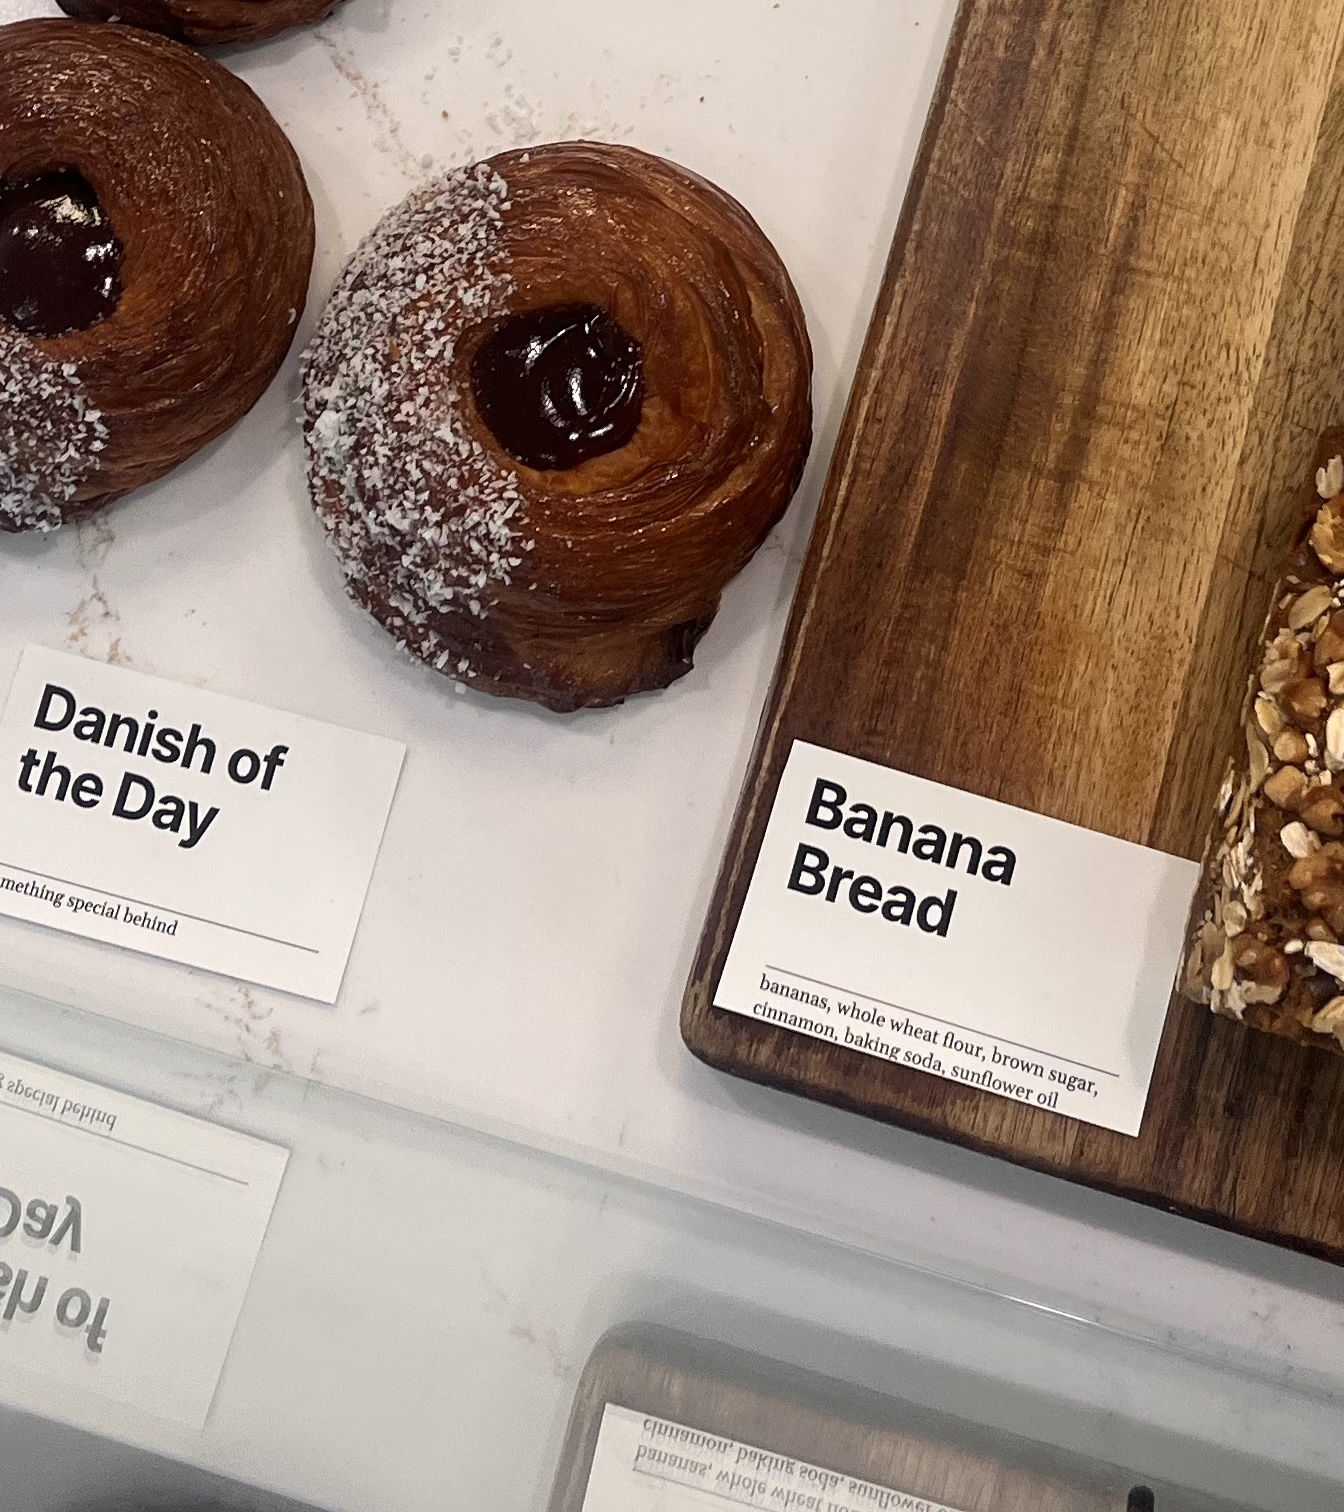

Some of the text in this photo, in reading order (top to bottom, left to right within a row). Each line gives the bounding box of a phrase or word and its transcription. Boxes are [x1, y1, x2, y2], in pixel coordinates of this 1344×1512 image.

[33, 683, 289, 791] Danish of
[17, 748, 220, 849] the Day
[804, 777, 1018, 886] Banana
[66, 892, 121, 921] special
[122, 907, 178, 936] behind
[787, 843, 958, 937] Bread
[752, 1000, 1059, 1109] cinnamon, baking soda, sunflower oil
[759, 974, 1099, 1098] bananas, whole wheat flour, brown sugar,
